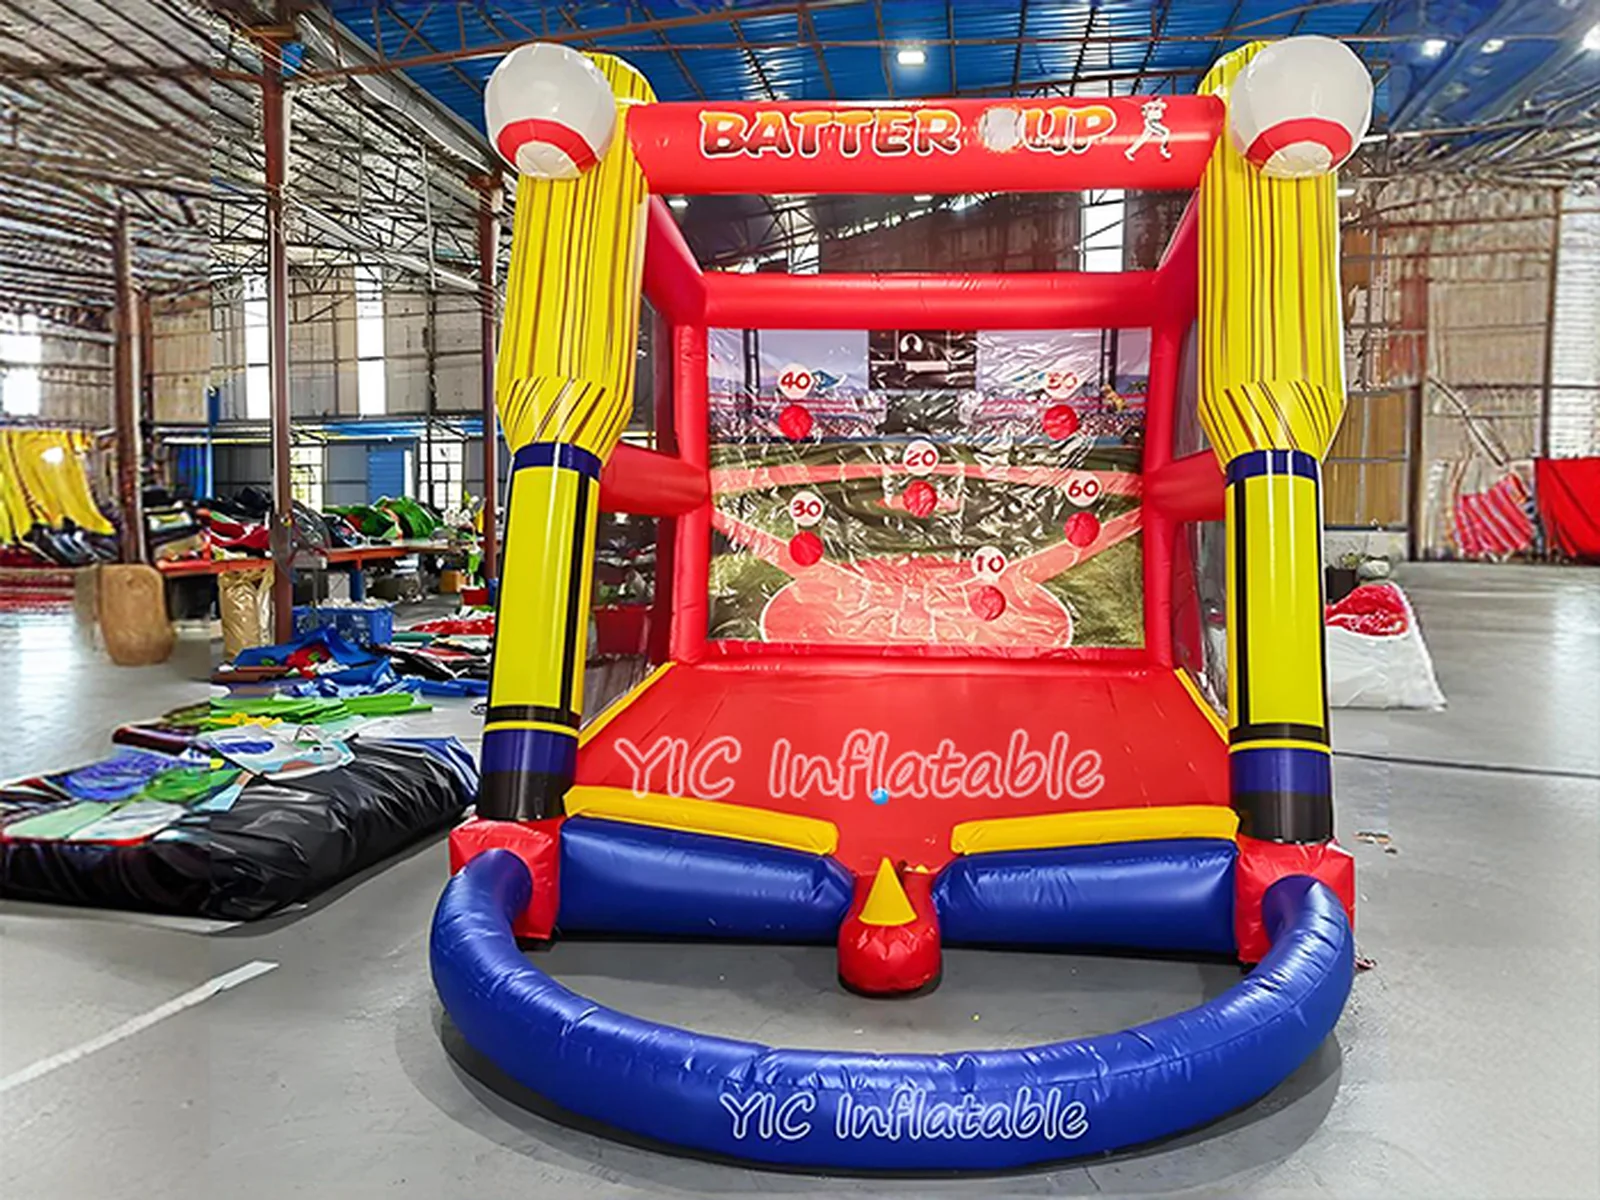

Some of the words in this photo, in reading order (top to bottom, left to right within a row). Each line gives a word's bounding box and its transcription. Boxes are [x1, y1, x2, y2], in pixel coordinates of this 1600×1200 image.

[698, 107, 962, 160] BATTER
[1021, 105, 1118, 154] UP
[781, 372, 811, 390] 40
[905, 449, 937, 468] 20
[1068, 479, 1099, 498] 60
[792, 500, 823, 518] 30
[976, 554, 1005, 573] 10
